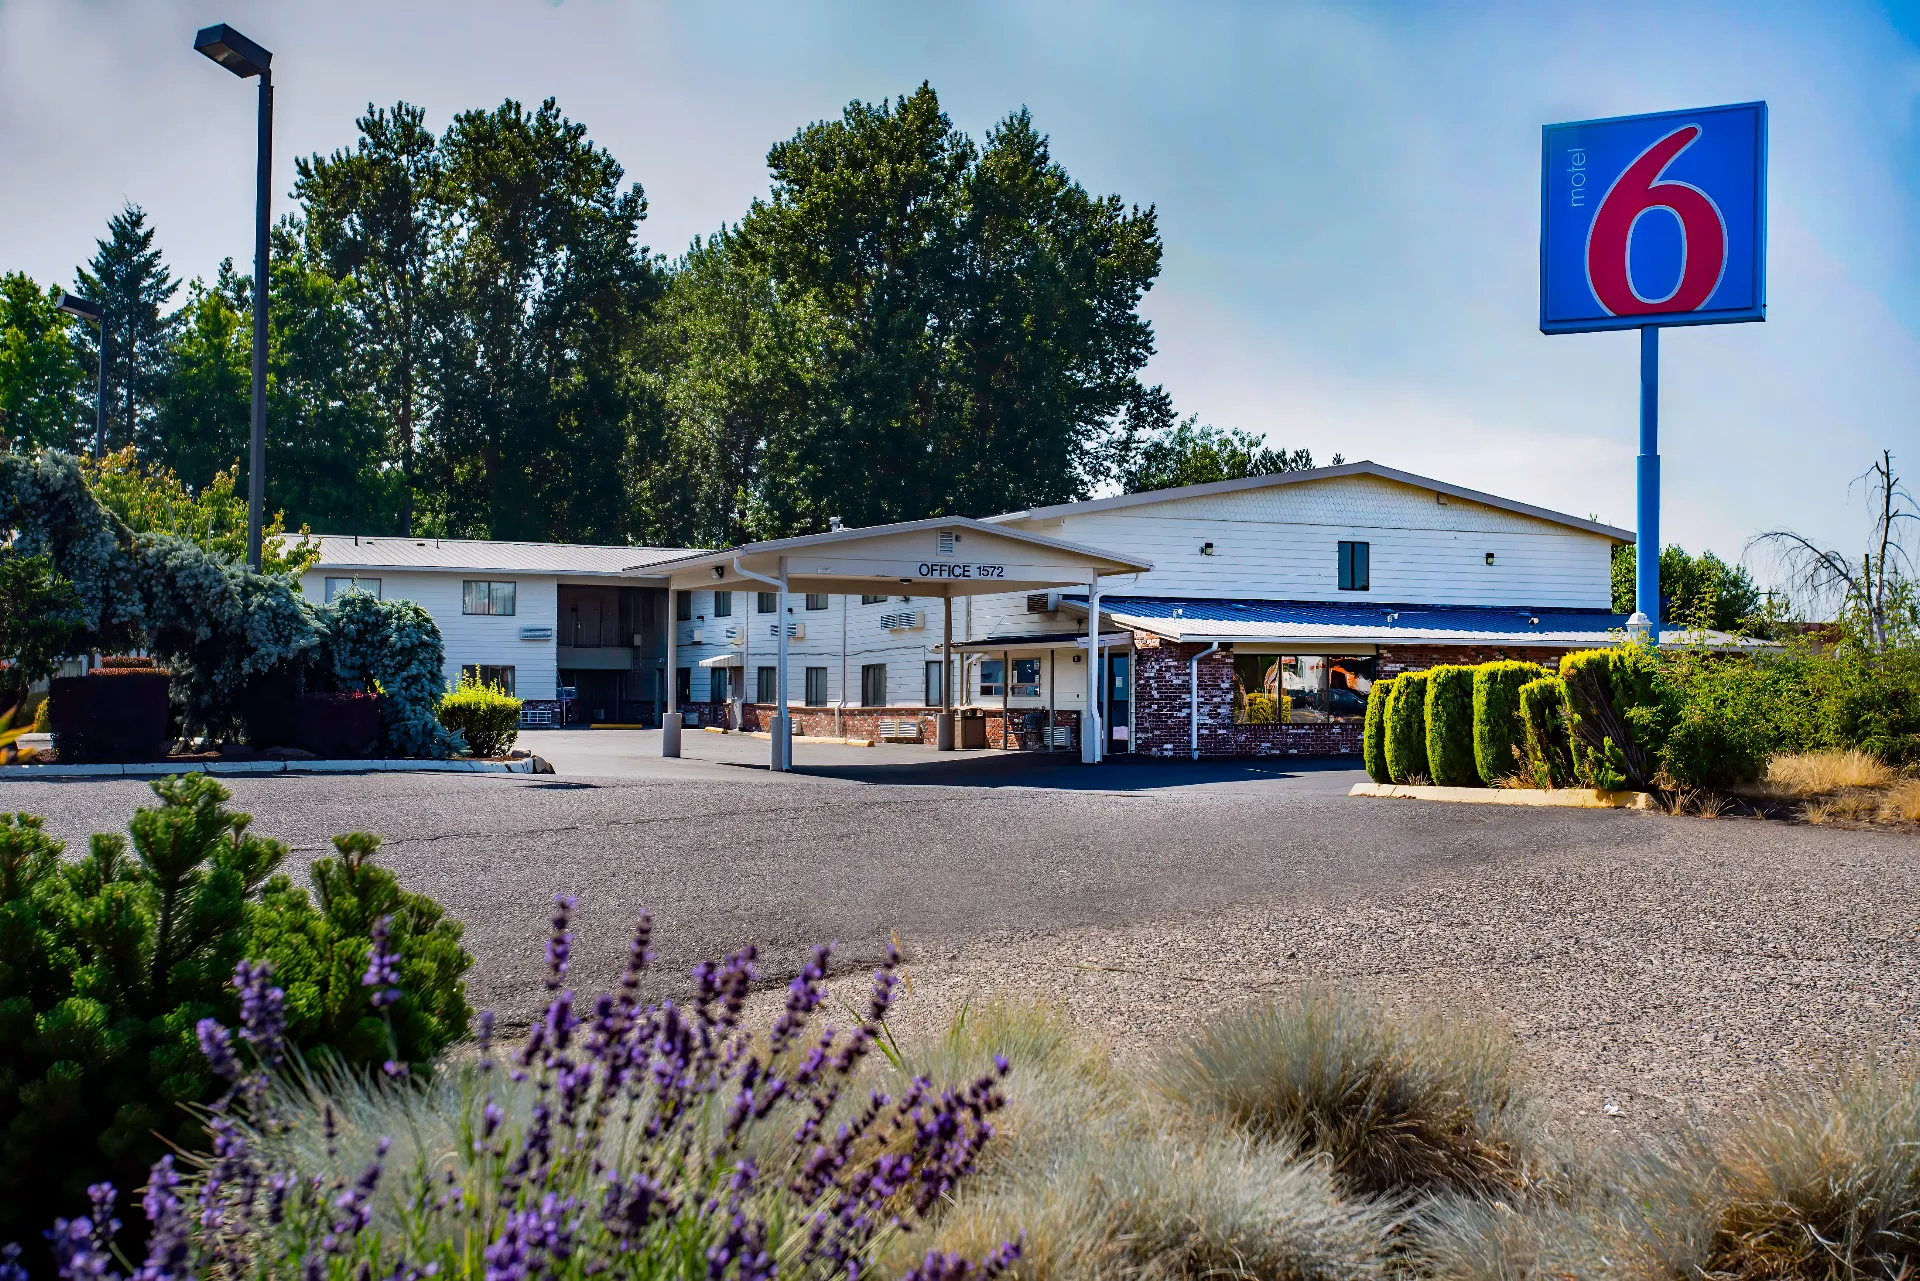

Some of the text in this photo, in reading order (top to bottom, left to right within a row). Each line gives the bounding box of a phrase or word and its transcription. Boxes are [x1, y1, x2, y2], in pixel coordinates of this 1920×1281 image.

[1567, 148, 1586, 207] motel
[1584, 123, 1728, 316] 6
[919, 563, 1004, 577] OFFICE 1572
